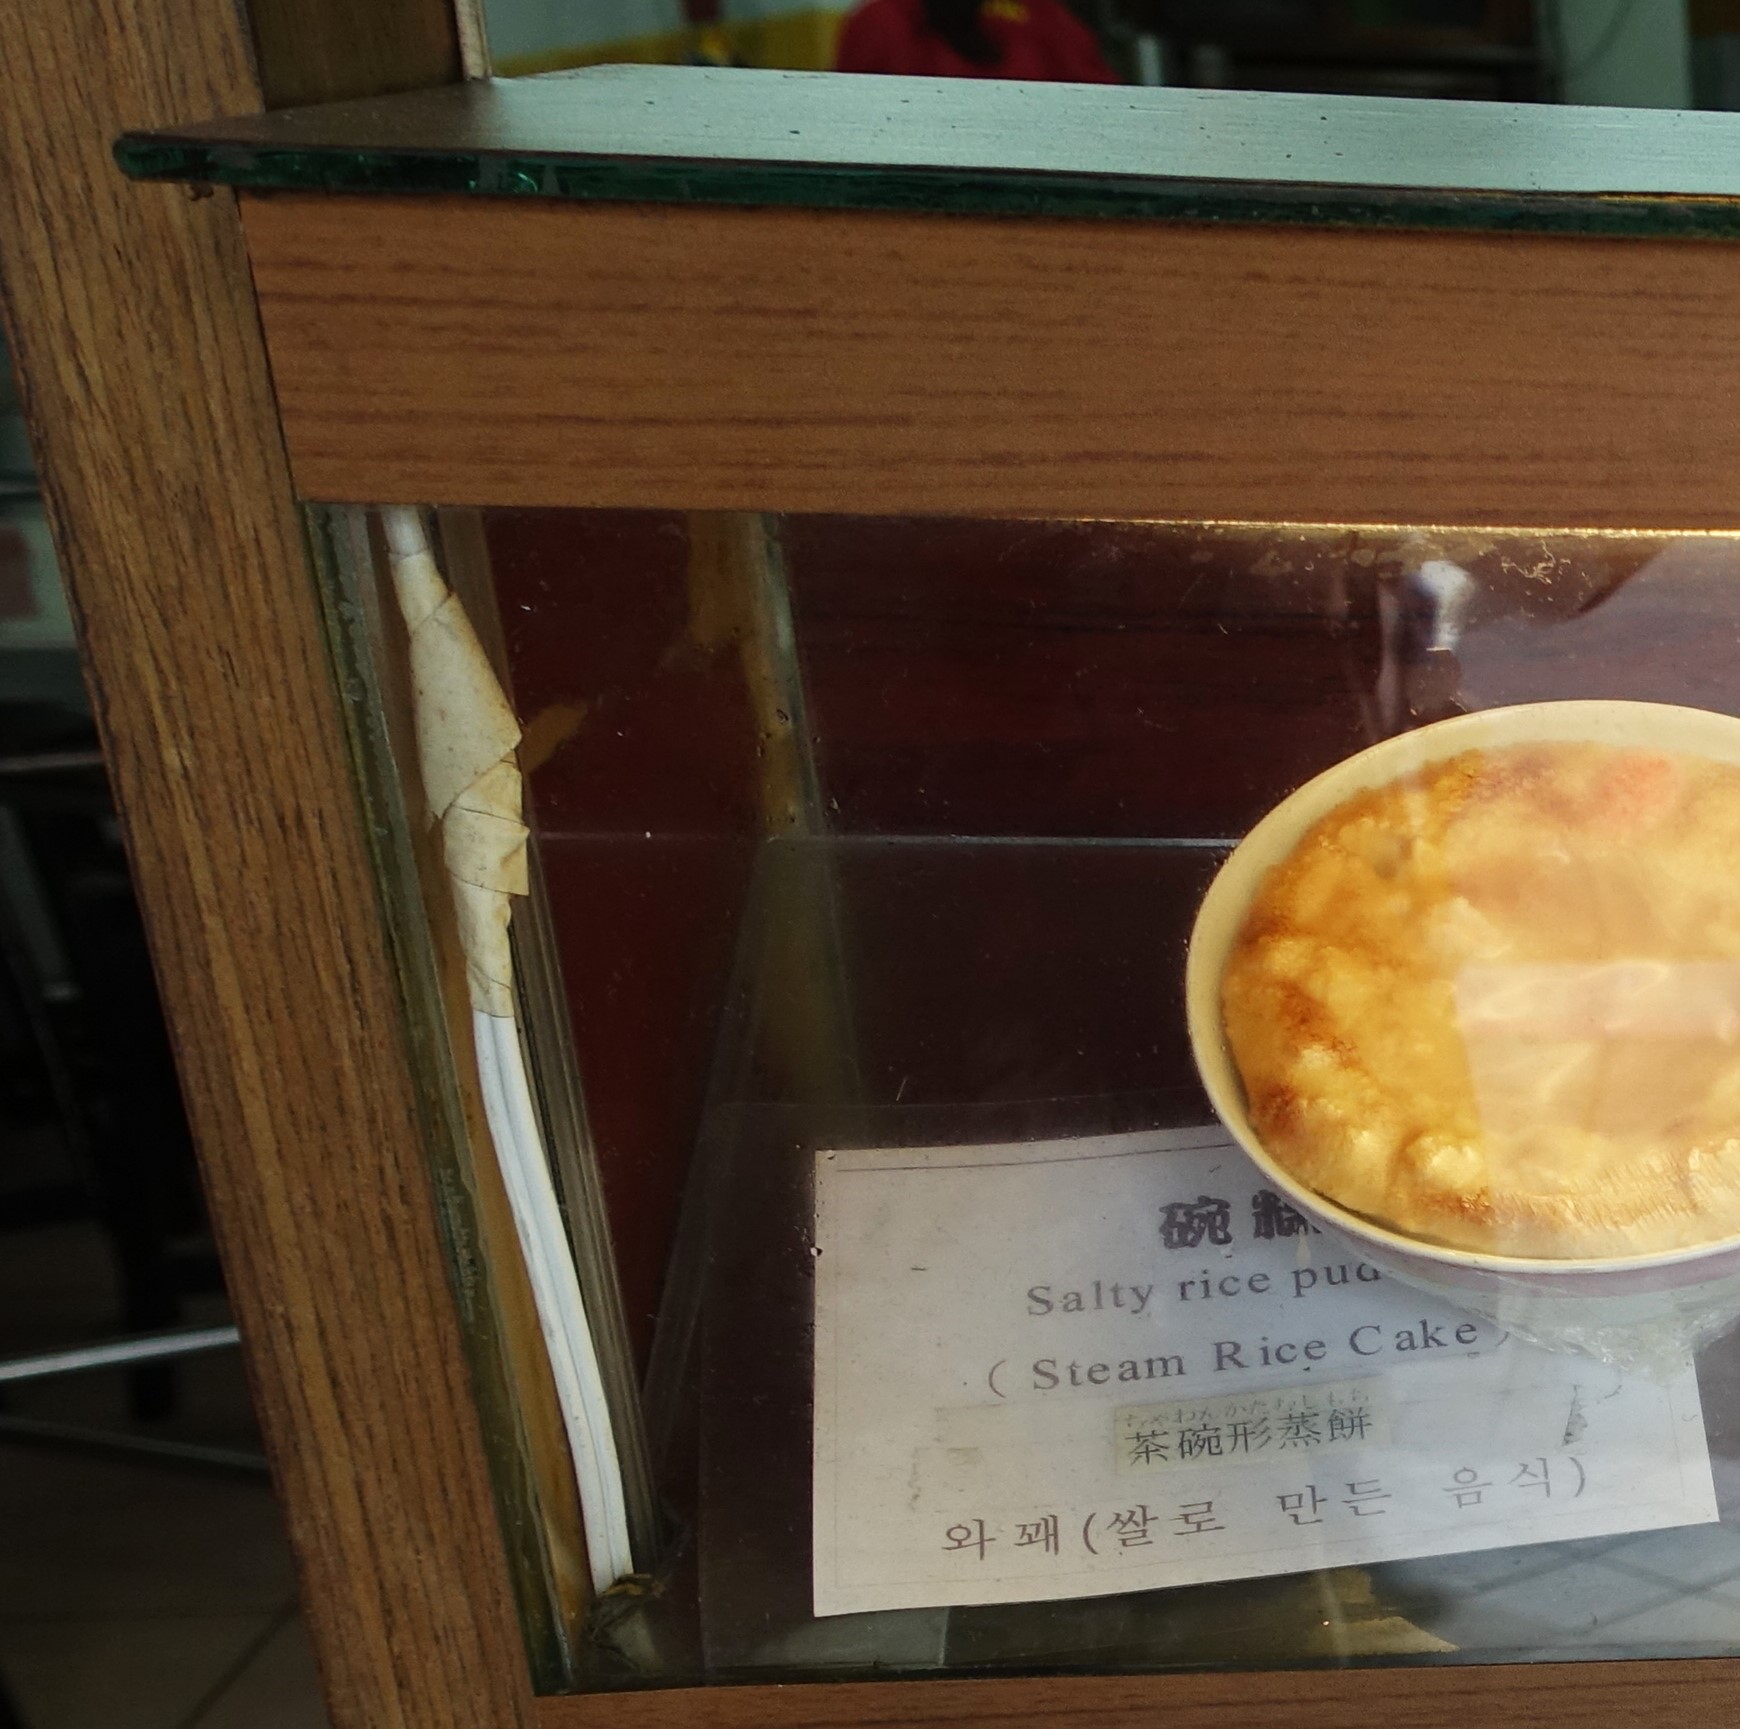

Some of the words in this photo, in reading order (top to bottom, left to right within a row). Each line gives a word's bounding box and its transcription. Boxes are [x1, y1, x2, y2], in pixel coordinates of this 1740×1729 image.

[1026, 1279, 1154, 1317] Salty
[1177, 1267, 1272, 1302] rice
[1213, 1334, 1328, 1373] Rice
[1124, 1406, 1373, 1466] 茶碗形蒸餅
[1277, 1477, 1393, 1529] 만든
[1440, 1456, 1587, 1510] 음식)
